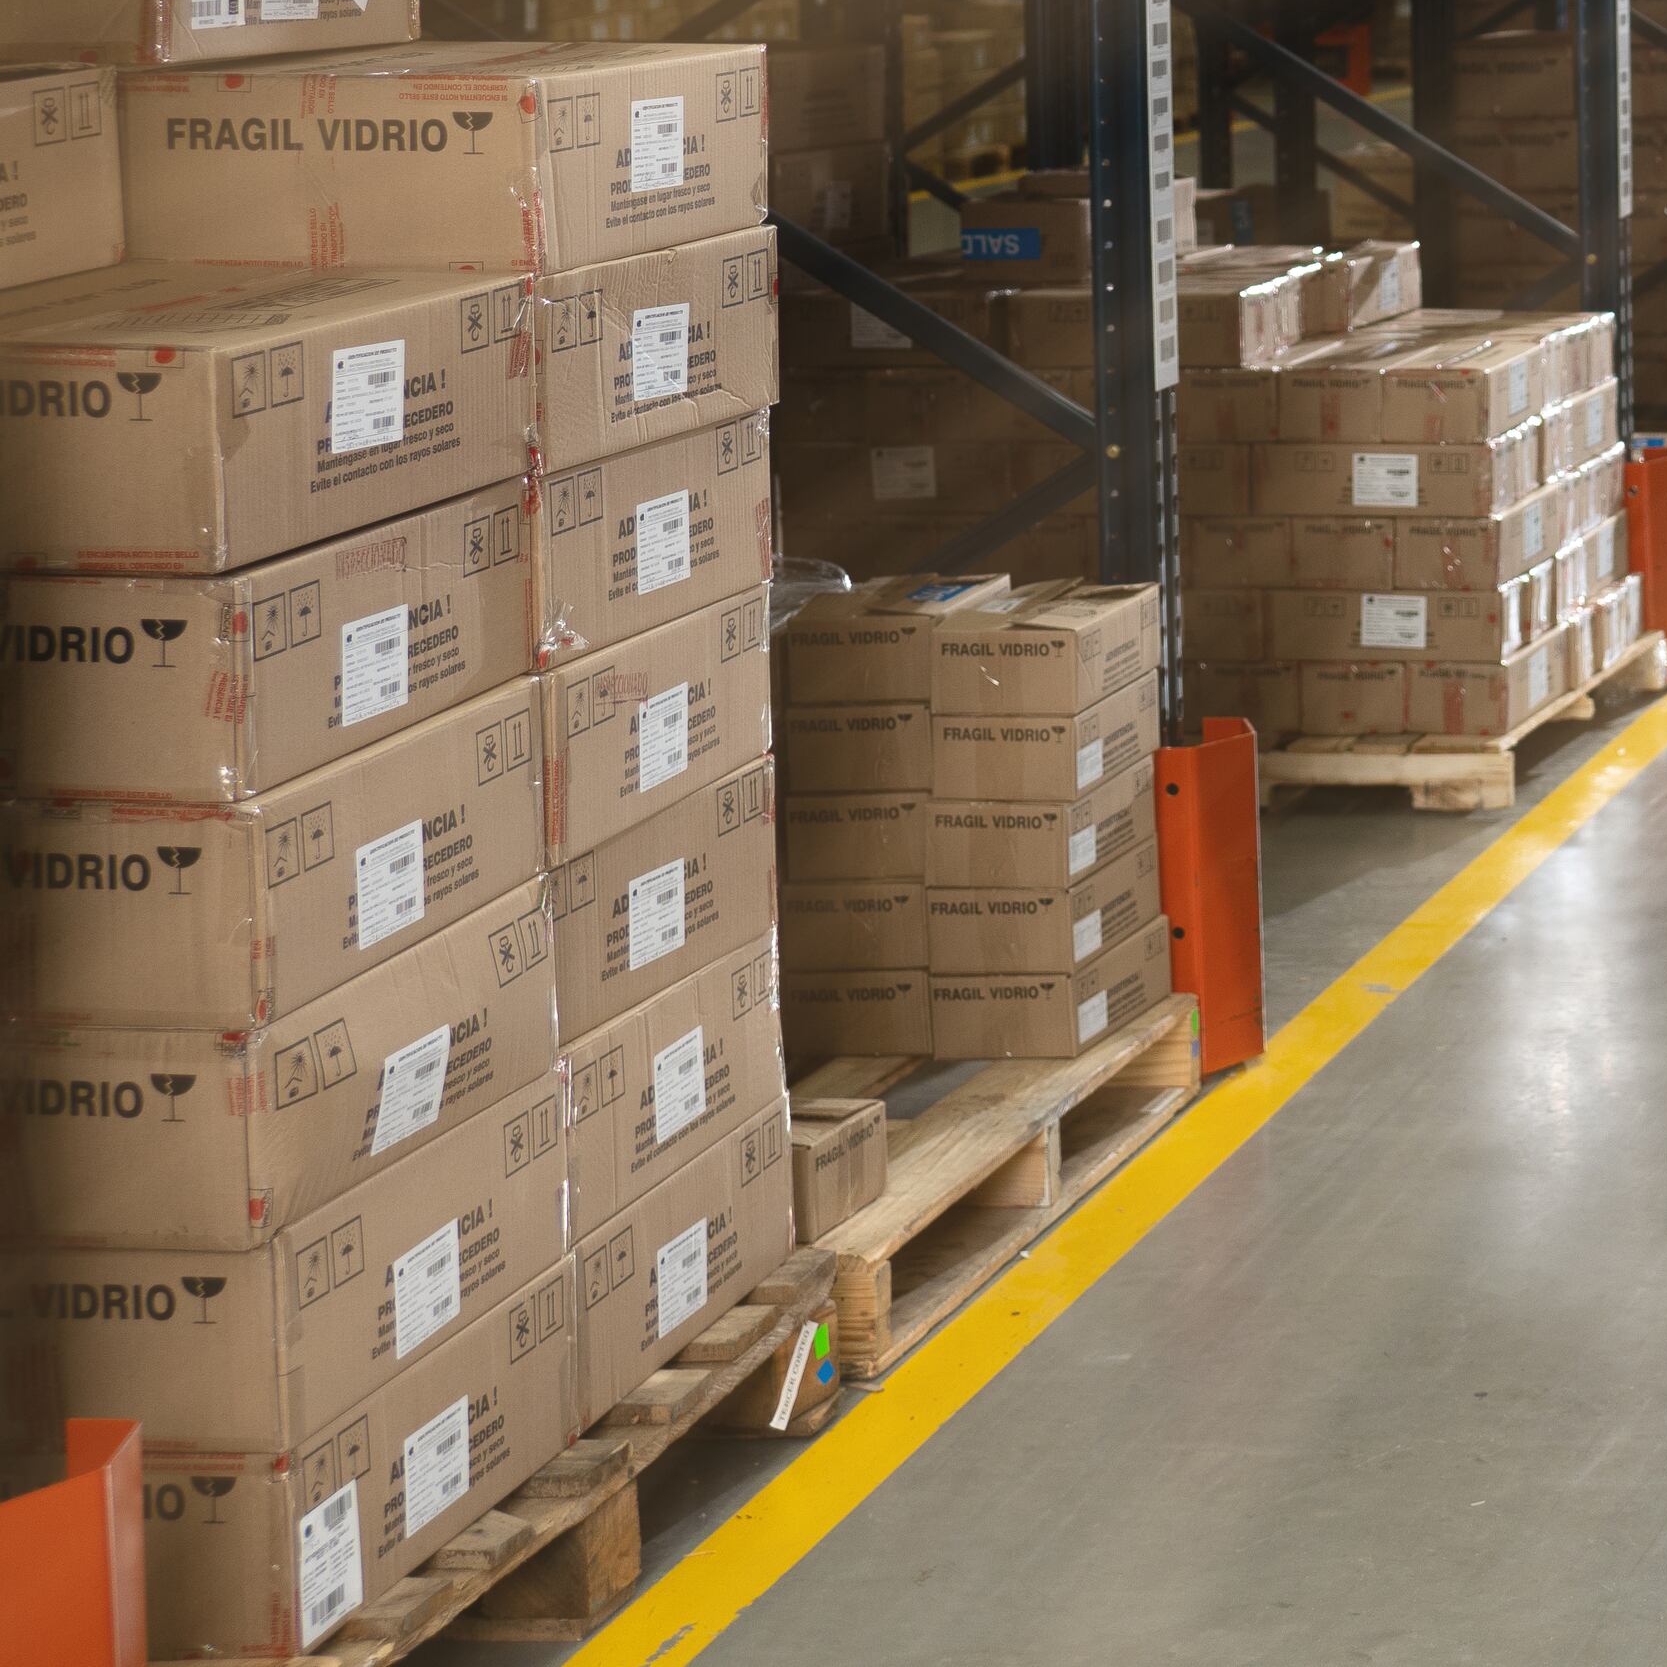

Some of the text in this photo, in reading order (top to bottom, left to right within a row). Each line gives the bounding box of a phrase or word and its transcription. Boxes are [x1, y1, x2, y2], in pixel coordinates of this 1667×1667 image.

[166, 116, 449, 153] FRAGIL VIDRIO
[697, 183, 711, 194] seco
[606, 217, 622, 229] Evite
[404, 400, 454, 429] ECEDERO
[317, 449, 368, 474] Manténgase
[369, 446, 380, 457] en
[403, 431, 428, 447] fresco
[435, 423, 454, 436] seco
[310, 436, 461, 494] Evite el contacto con los rayos solares
[408, 625, 459, 659] RECEDERO
[849, 629, 899, 645] VIDRIO
[941, 641, 1050, 657] FRAGIL VIDRIO
[412, 655, 436, 673] fresco
[442, 647, 460, 660] seco
[418, 660, 466, 689] rayos solares
[846, 716, 897, 731] VIDRIO
[943, 726, 1050, 742] FRAGIL VIDRIO
[848, 806, 899, 822] VIDRIO
[935, 813, 1042, 830] FRAGIL VIDRIO
[427, 868, 450, 888] fresco
[456, 855, 474, 870] seco
[433, 869, 480, 902] rayos solares
[930, 900, 1038, 916] FRAGIL VIDRIO
[933, 986, 1040, 1001] FRAGIL VIDRIO
